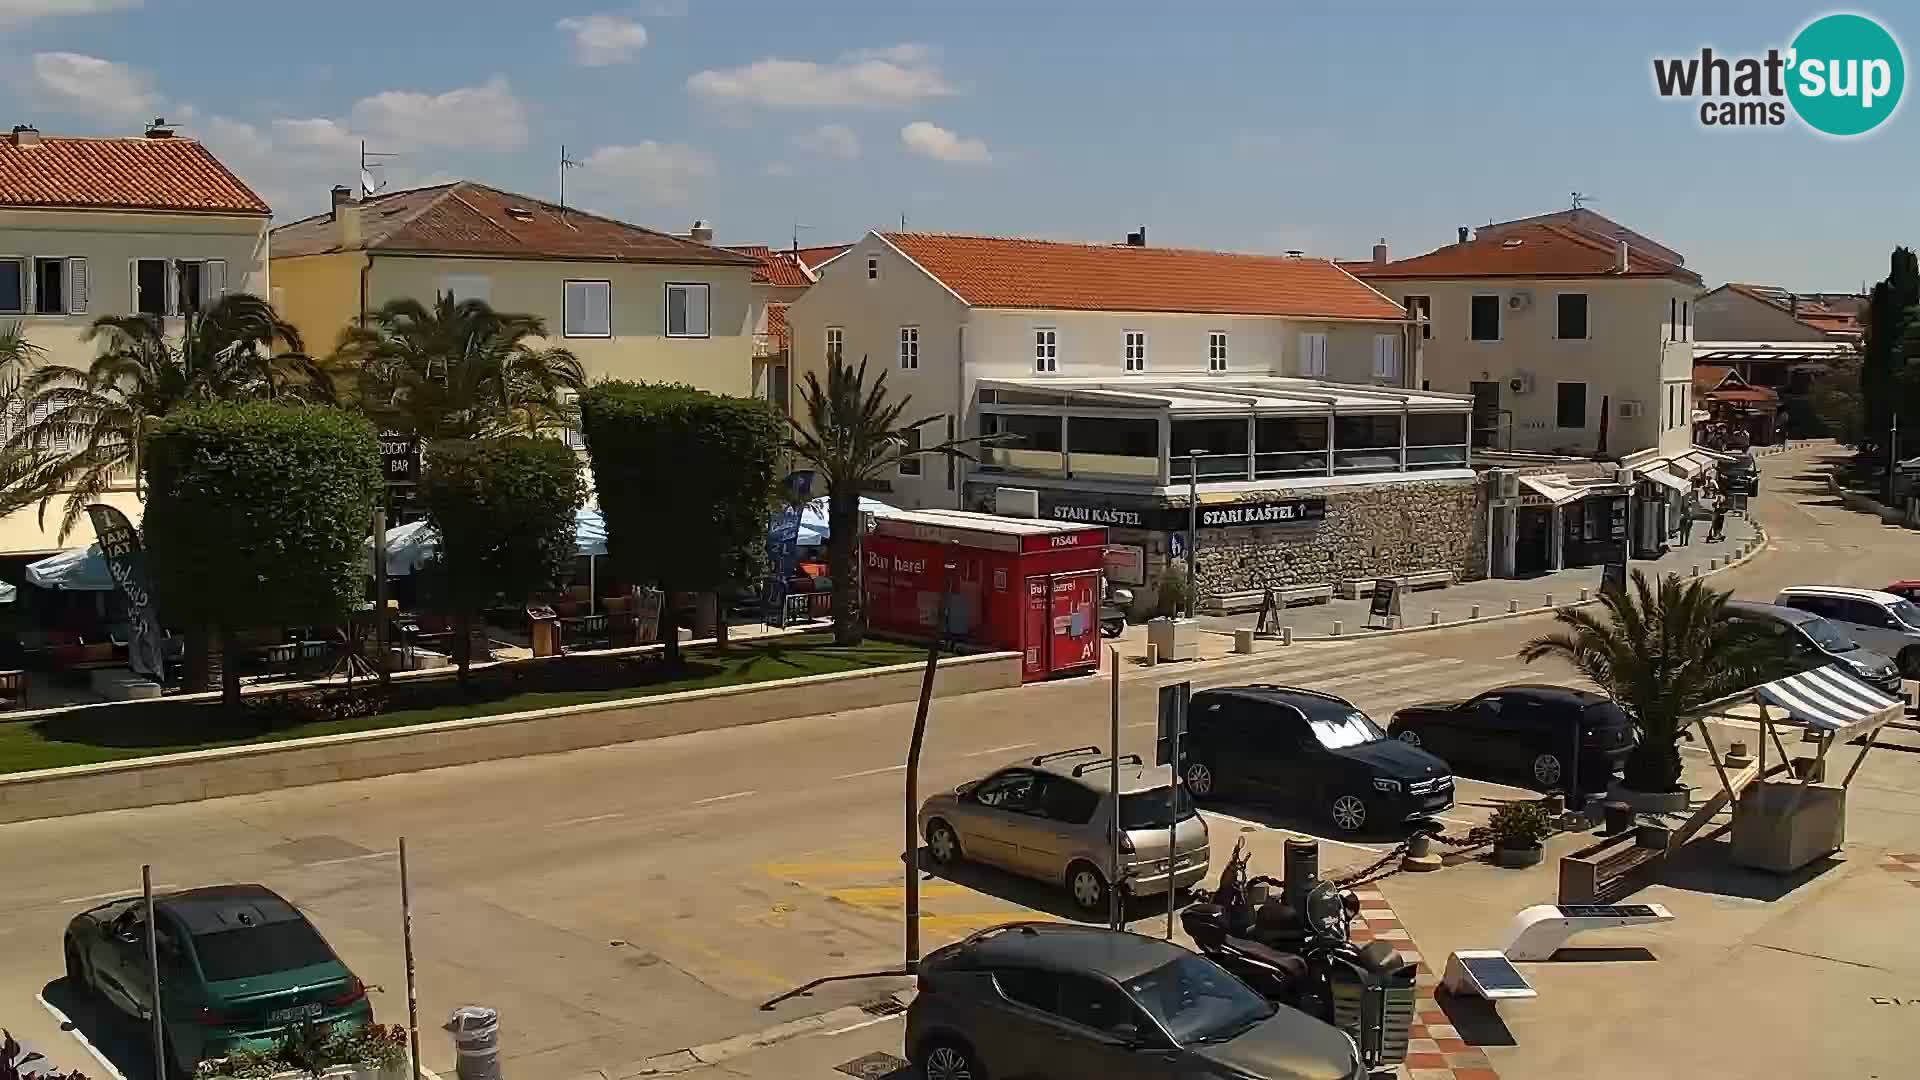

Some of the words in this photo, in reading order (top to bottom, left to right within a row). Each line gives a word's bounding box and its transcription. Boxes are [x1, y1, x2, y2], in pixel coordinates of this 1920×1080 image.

[391, 460, 408, 472] BAR
[1054, 506, 1089, 520] STARI
[1092, 508, 1141, 525] KAŠTEL
[1203, 509, 1242, 525] STARI
[1245, 504, 1294, 521] KAŠTEL
[894, 554, 925, 573] here!
[1081, 641, 1094, 660] A1
